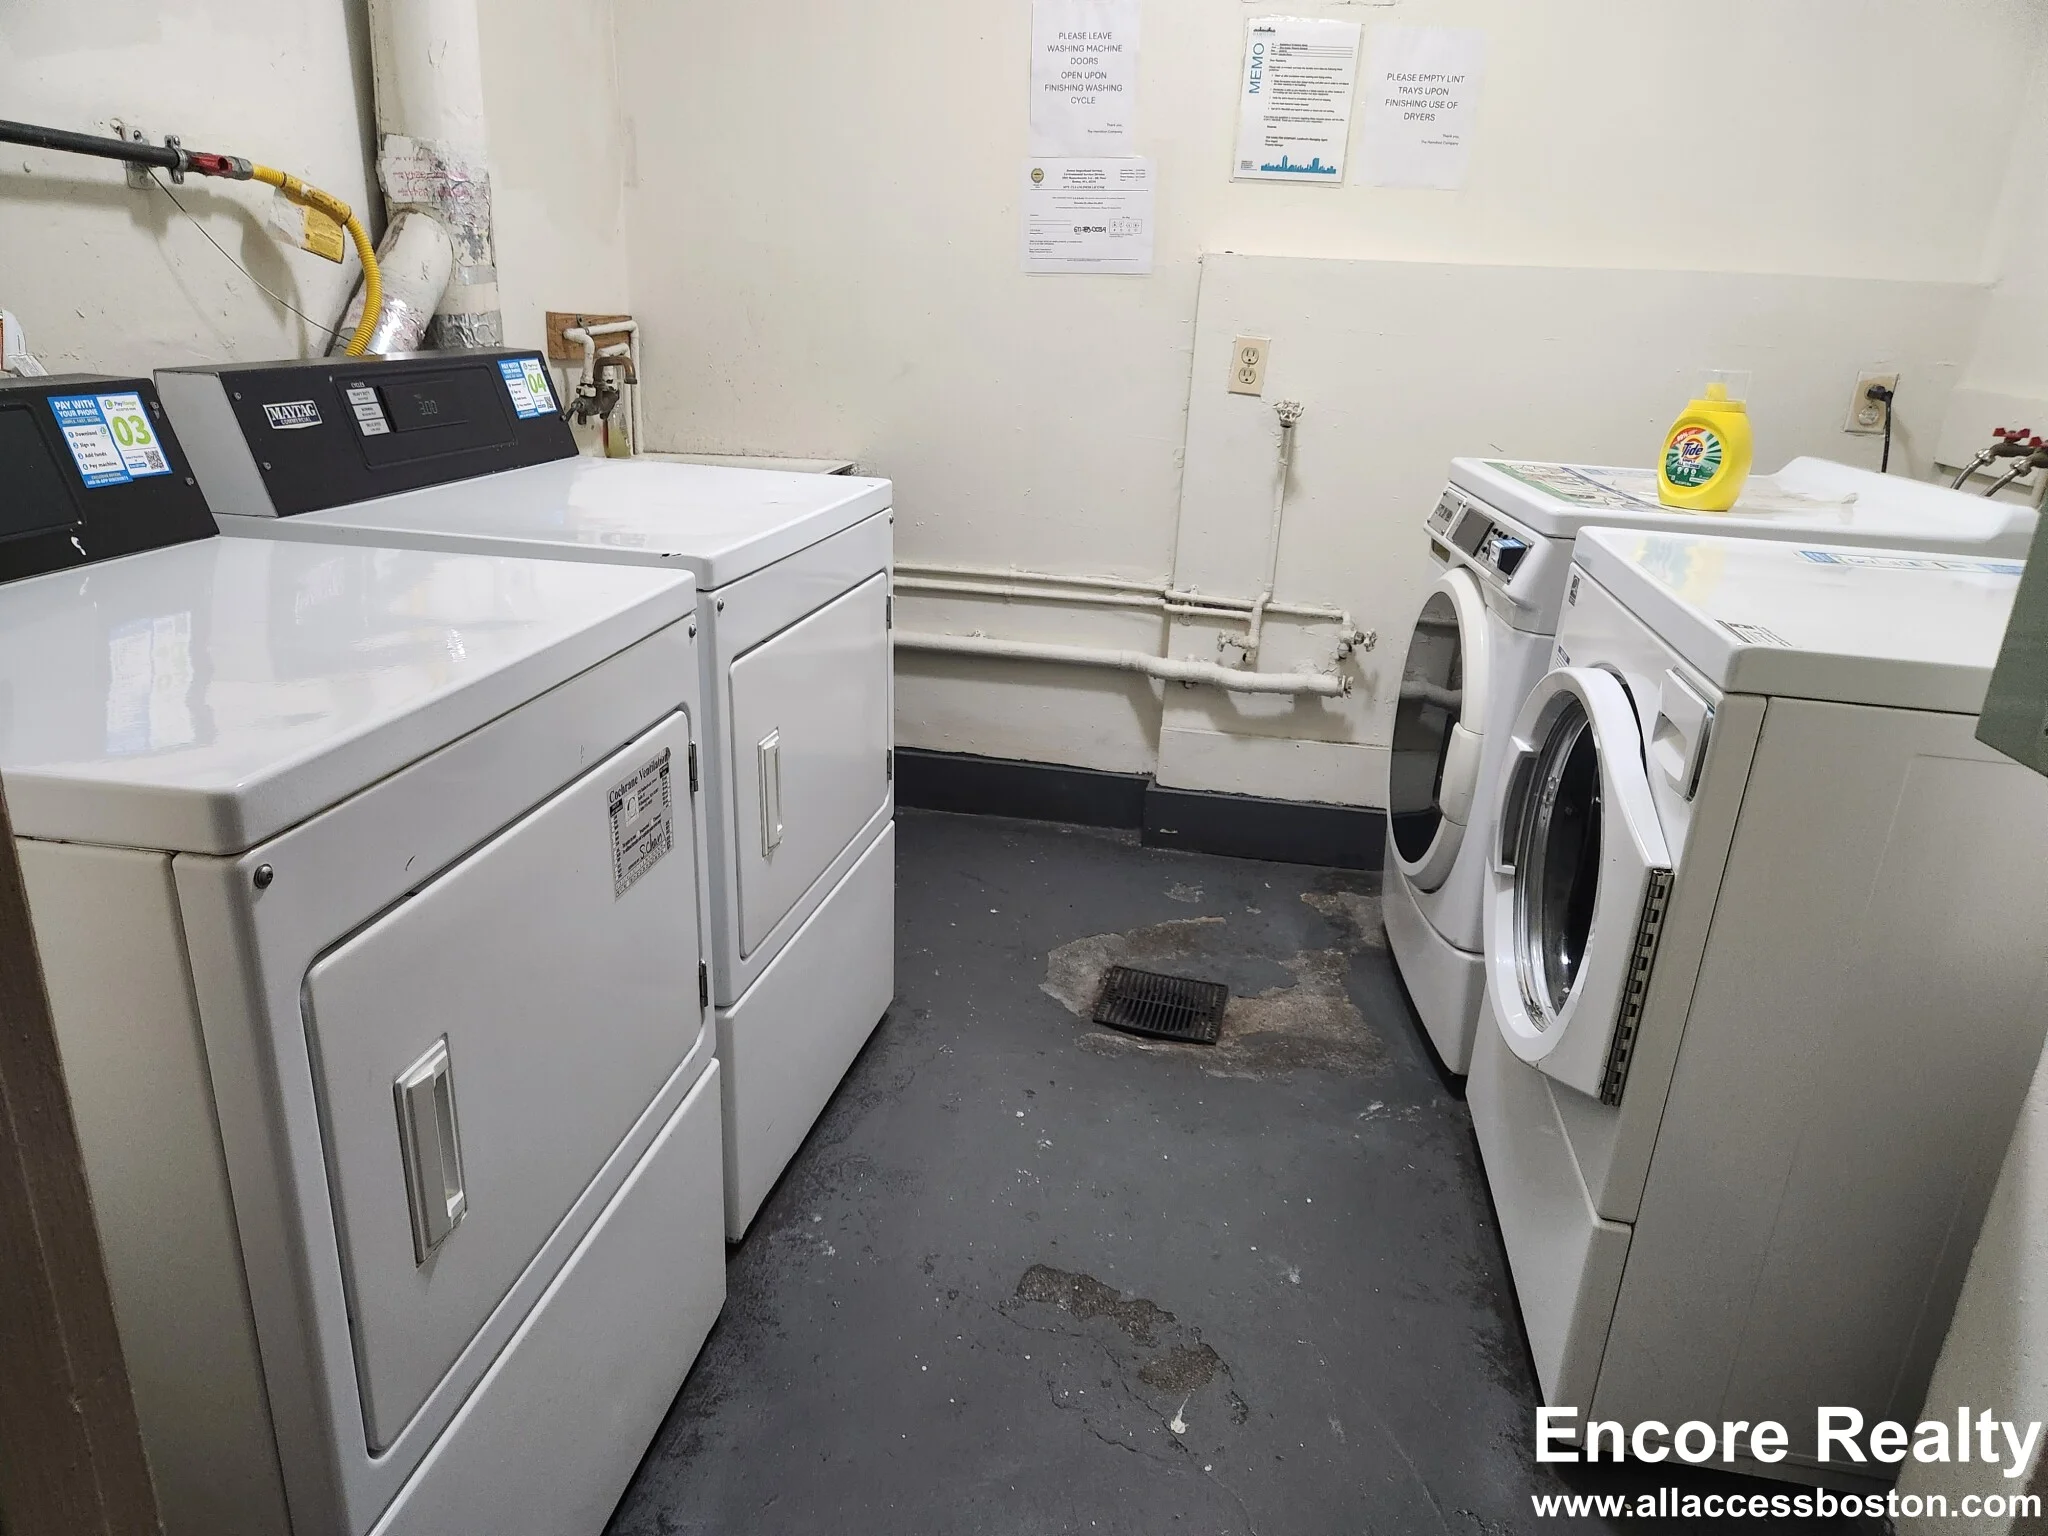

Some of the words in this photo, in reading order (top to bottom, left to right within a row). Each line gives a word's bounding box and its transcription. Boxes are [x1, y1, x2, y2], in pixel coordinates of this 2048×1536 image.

[1058, 32, 1087, 40] PLEASE
[1088, 32, 1112, 40] LEAVE
[1070, 57, 1099, 65] DOORS
[1249, 43, 1264, 94] MEMO
[1386, 73, 1417, 82] PLEASE
[1418, 74, 1446, 82] EMPTY
[1446, 75, 1465, 83] LINT
[1044, 84, 1084, 92] FINISHING
[1085, 84, 1123, 92] WASHING
[1398, 86, 1423, 95] TRAYS
[1425, 88, 1450, 96] UPON
[1385, 99, 1427, 108] FINISHING
[1428, 100, 1445, 109] USE
[1446, 101, 1458, 109] OF
[1403, 112, 1436, 121] DRYERS
[528, 373, 547, 394] 04
[54, 400, 71, 410] PAY
[71, 400, 96, 409] WITH
[77, 409, 98, 417] PHONE
[268, 403, 316, 421] MAYTAG
[280, 417, 312, 425] COMMERCIAL
[112, 415, 151, 446] 03
[1681, 443, 1703, 458] Tide
[609, 776, 638, 803] Cochrane
